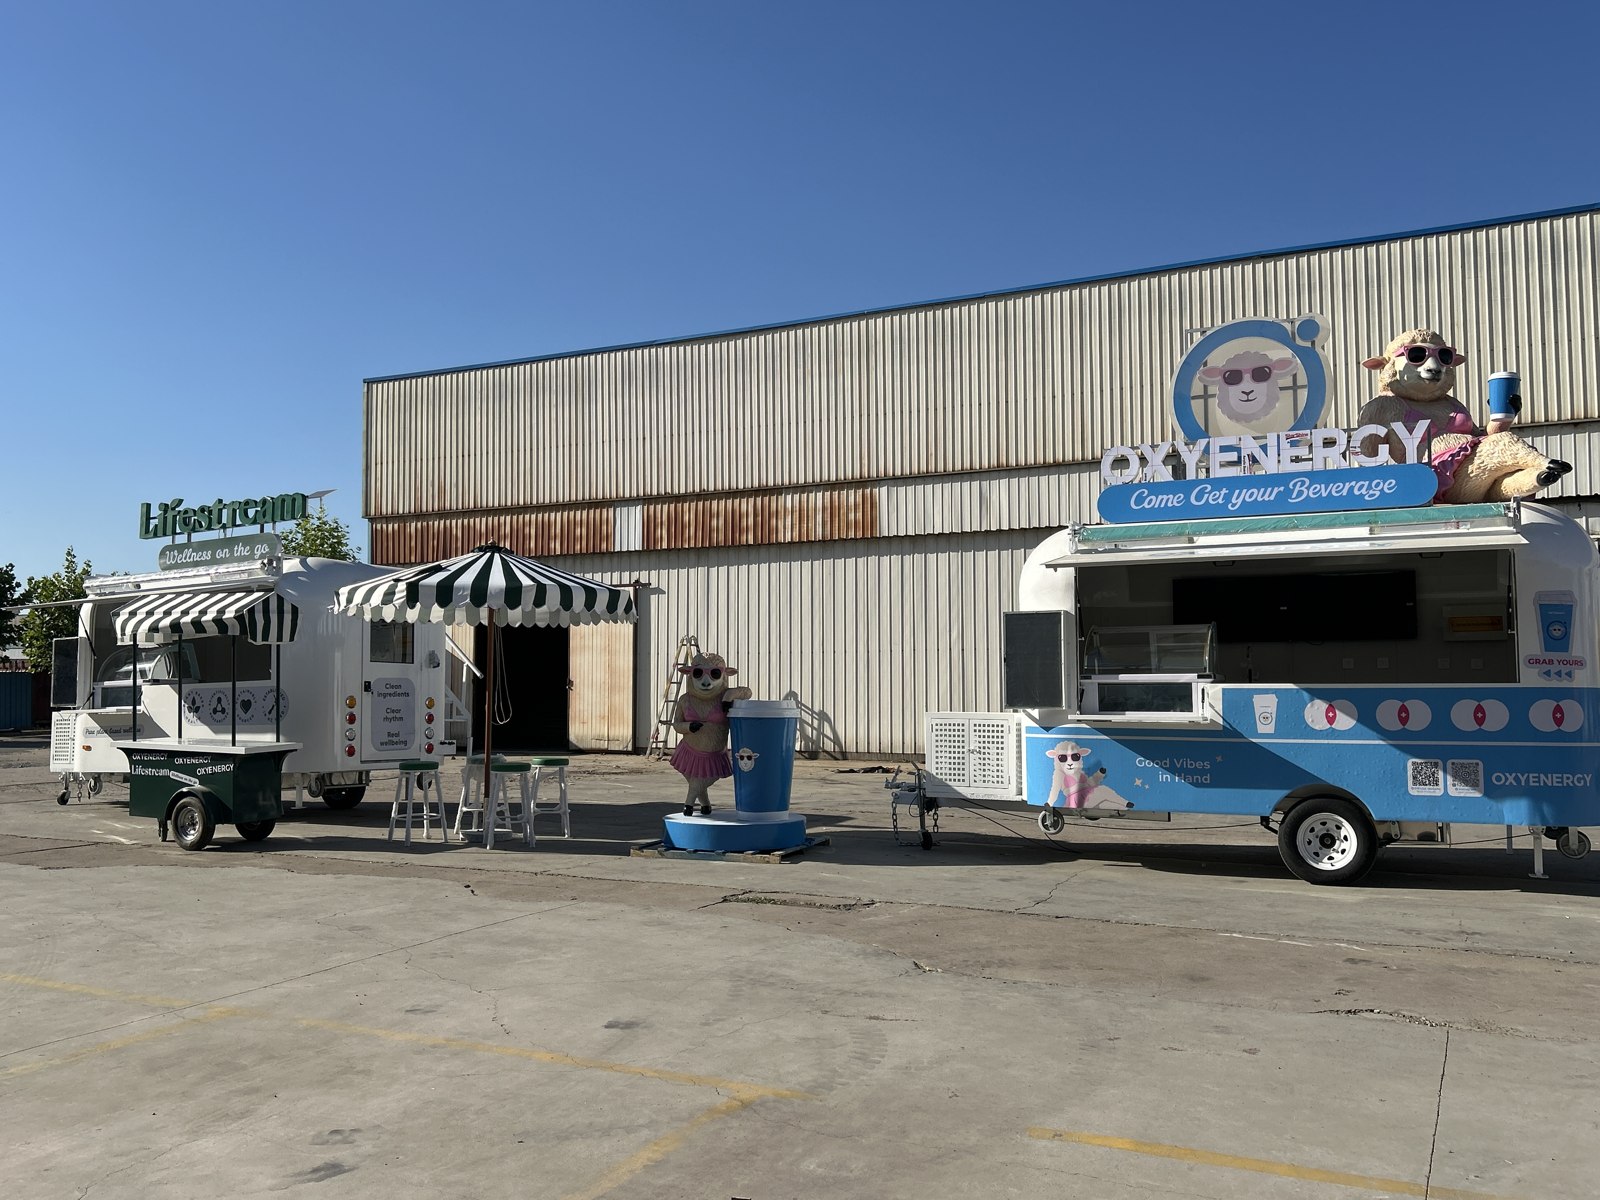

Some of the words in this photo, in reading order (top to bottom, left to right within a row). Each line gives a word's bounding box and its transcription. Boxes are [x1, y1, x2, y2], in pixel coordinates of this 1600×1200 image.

[1100, 419, 1431, 487] OXYENERGY
[1130, 488, 1185, 510] Come
[1190, 484, 1225, 506] Get
[1228, 486, 1284, 511] your
[1287, 476, 1398, 503] Beverage
[139, 493, 308, 539] Lifestream
[165, 549, 212, 565] Wellness
[216, 549, 230, 559] on
[234, 543, 250, 557] the
[254, 544, 270, 559] go
[1528, 658, 1554, 666] GRAB
[1556, 659, 1583, 667] YOURS
[377, 690, 410, 699] ingredients
[383, 715, 404, 723] rhythm
[380, 738, 408, 747] wellbeing
[132, 753, 168, 761] OXYENERGY
[174, 756, 211, 765] OXYENERGY
[1135, 757, 1170, 768] Good
[1173, 758, 1211, 769] Vibes
[131, 765, 170, 777] Lifestream
[196, 763, 234, 776] OXYENERGY
[1159, 771, 1171, 782] in
[1175, 773, 1211, 783] Hand
[1491, 772, 1593, 787] OXYENERGY
